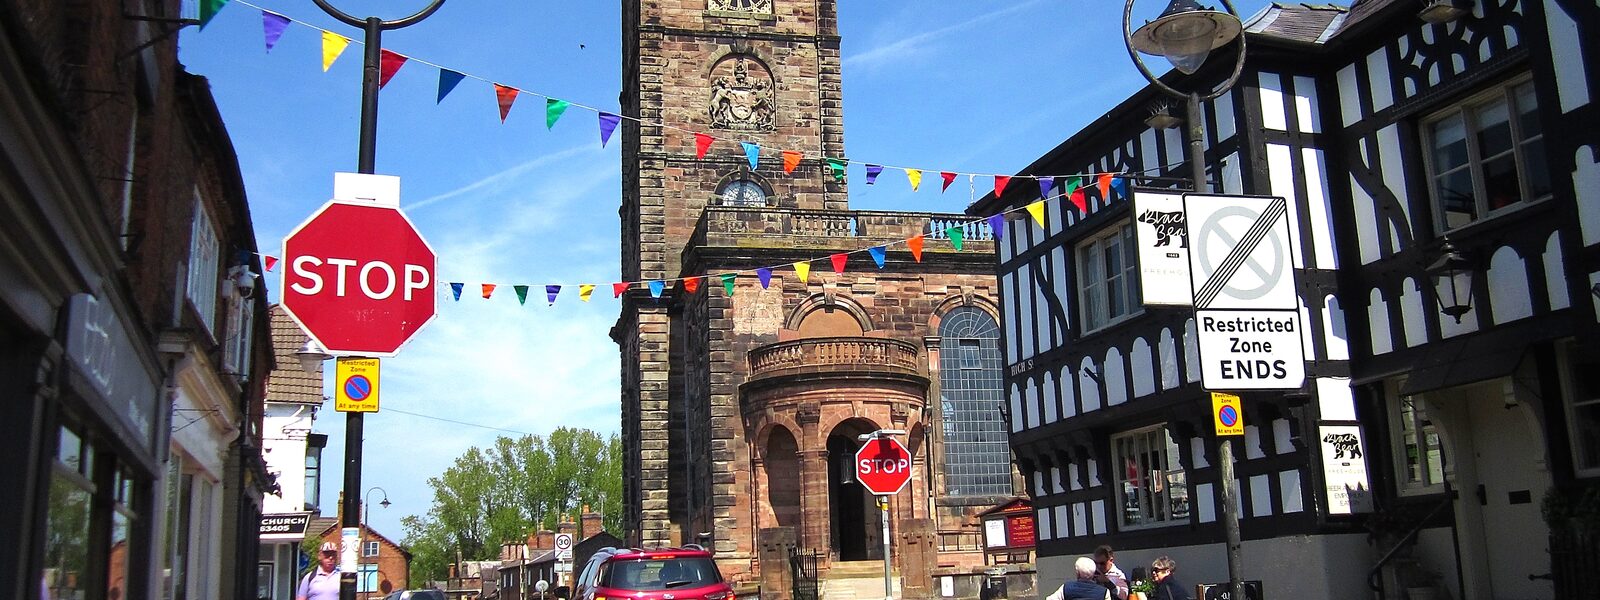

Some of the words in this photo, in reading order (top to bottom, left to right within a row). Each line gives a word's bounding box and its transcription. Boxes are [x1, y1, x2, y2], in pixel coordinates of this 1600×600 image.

[1156, 224, 1187, 240] Bea
[290, 255, 430, 301] STOP
[1203, 316, 1294, 332] Restricted
[1229, 337, 1272, 353] Zone
[1220, 360, 1287, 379] ENDS
[1326, 433, 1358, 443] Black
[1334, 443, 1359, 454] Bear
[860, 458, 908, 475] STOP
